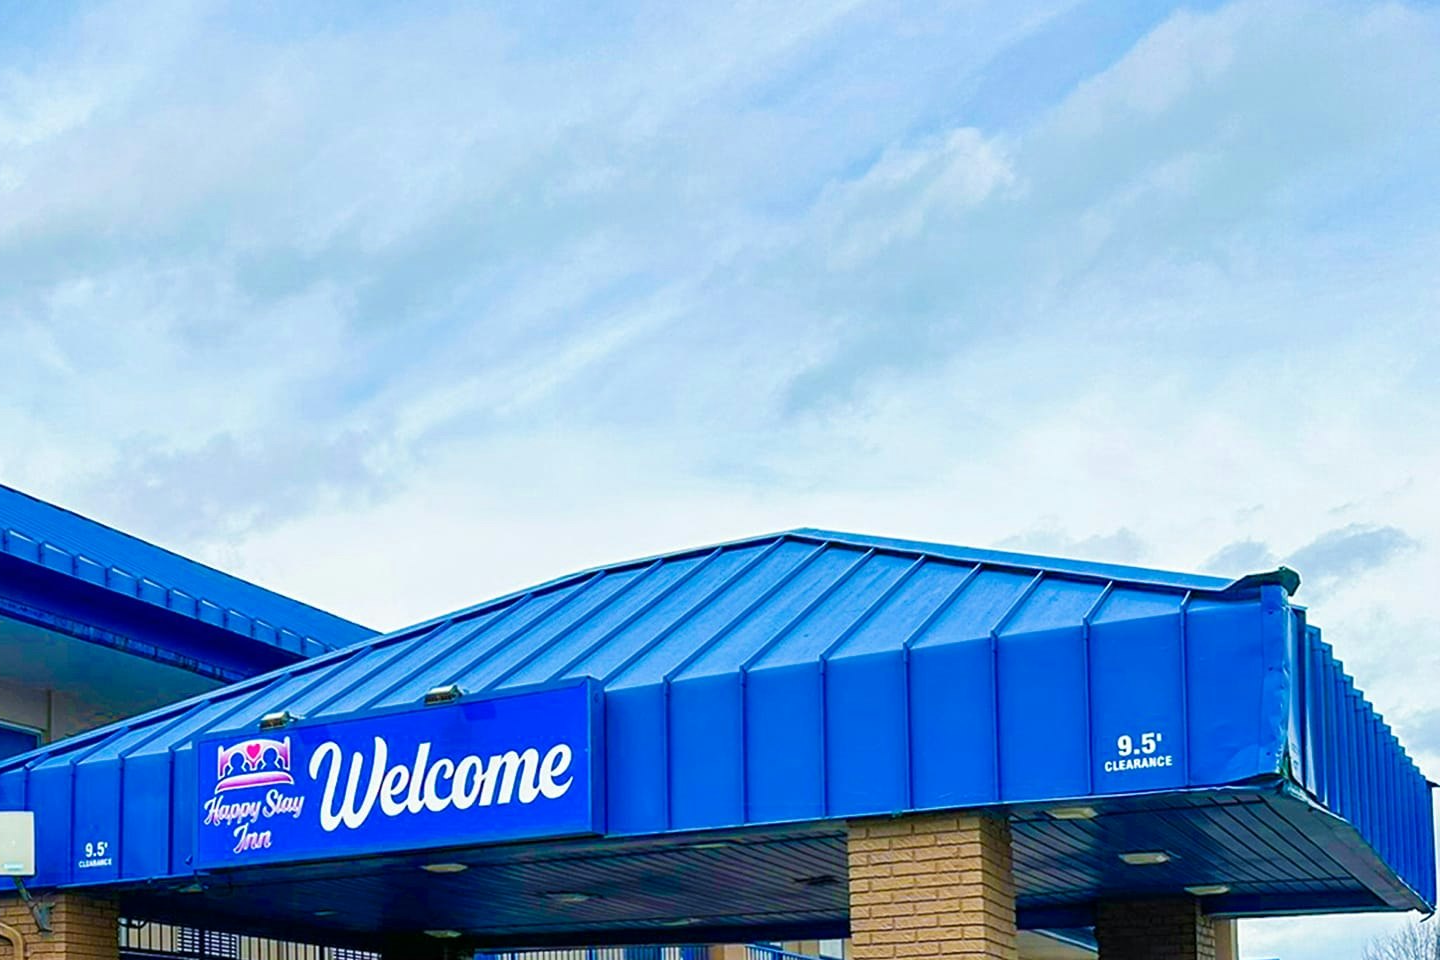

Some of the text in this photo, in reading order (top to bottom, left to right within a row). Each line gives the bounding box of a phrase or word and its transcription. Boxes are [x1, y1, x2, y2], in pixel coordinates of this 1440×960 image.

[1117, 732, 1162, 756] 9.5'
[1104, 755, 1173, 772] CLEARANCE
[309, 736, 574, 832] Welcome
[204, 789, 305, 826] Happy Stay
[85, 841, 108, 858] 9.5'
[233, 823, 272, 854] Inn
[78, 858, 112, 868] CLEARANCE
